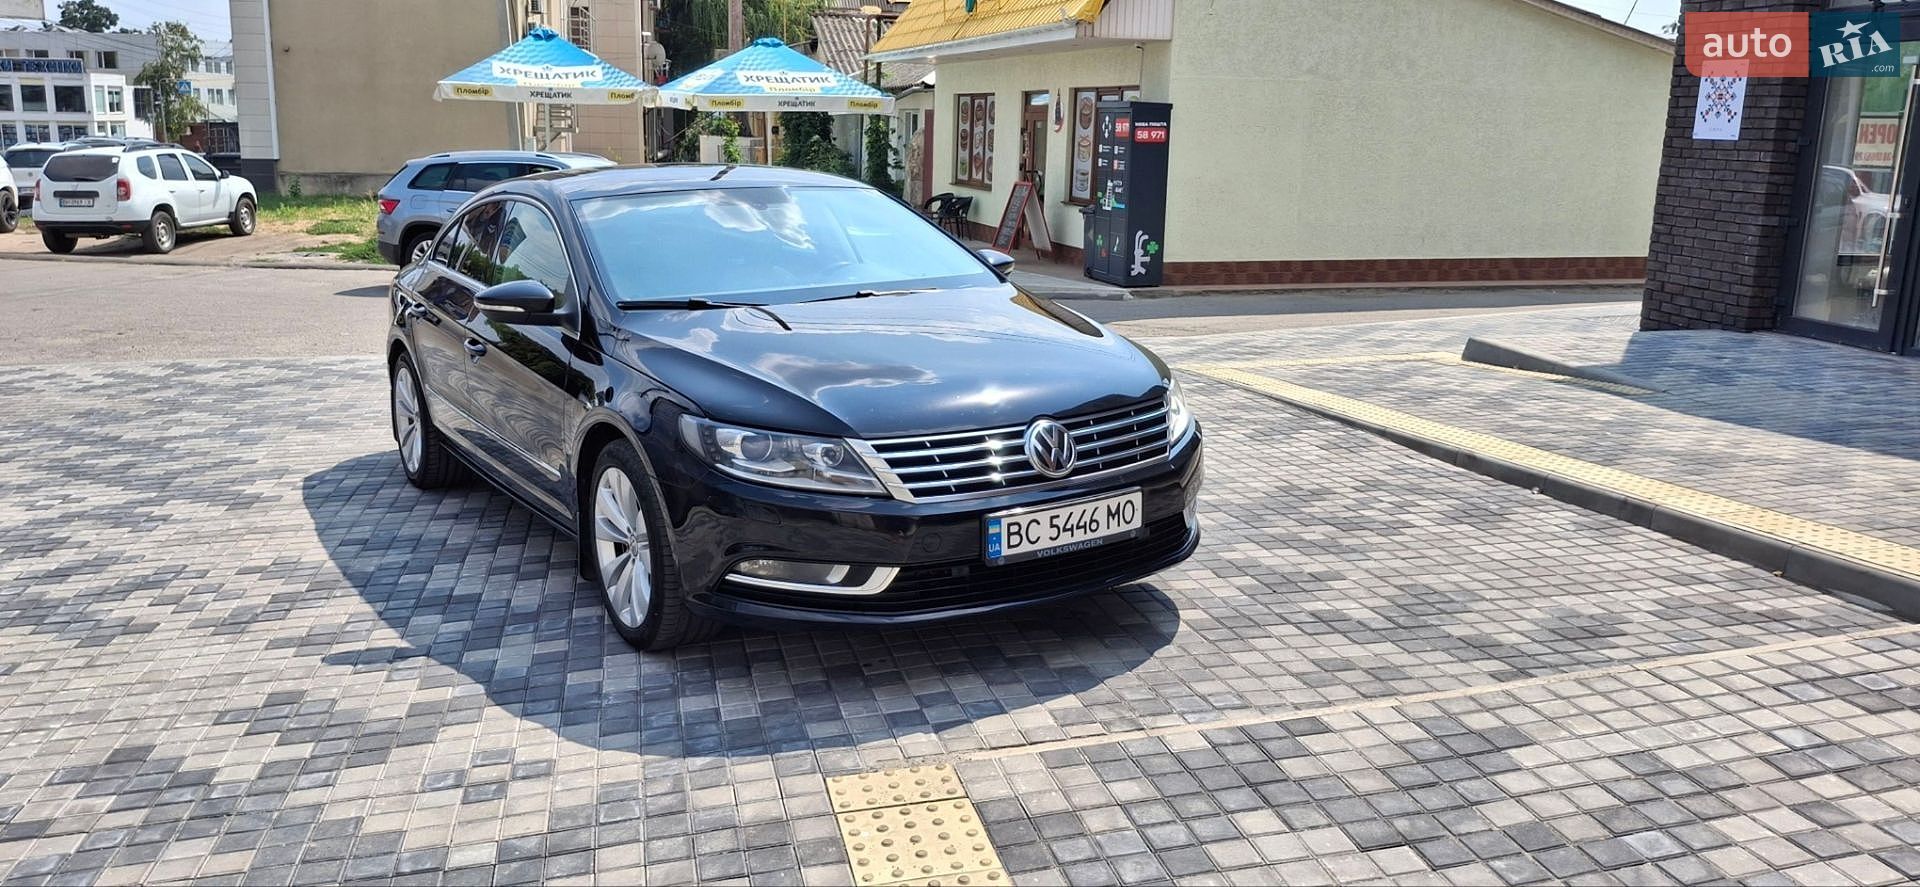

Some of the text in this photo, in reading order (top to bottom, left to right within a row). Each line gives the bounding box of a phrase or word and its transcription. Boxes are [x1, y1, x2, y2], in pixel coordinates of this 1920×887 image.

[499, 66, 597, 81] ХРЕЩАТИК
[743, 75, 831, 86] ХРЕЩАТИК
[456, 87, 489, 97] Пломбір
[529, 90, 573, 99] ХРЕЩАТИК
[778, 100, 816, 108] ХРЕЩАТИК
[850, 101, 878, 109] Пломбір
[1137, 130, 1165, 139] 58 971
[1005, 499, 1136, 551] BC 5446 MO
[988, 543, 1000, 553] UA
[1036, 538, 1104, 558] VOLKSWAGEN
